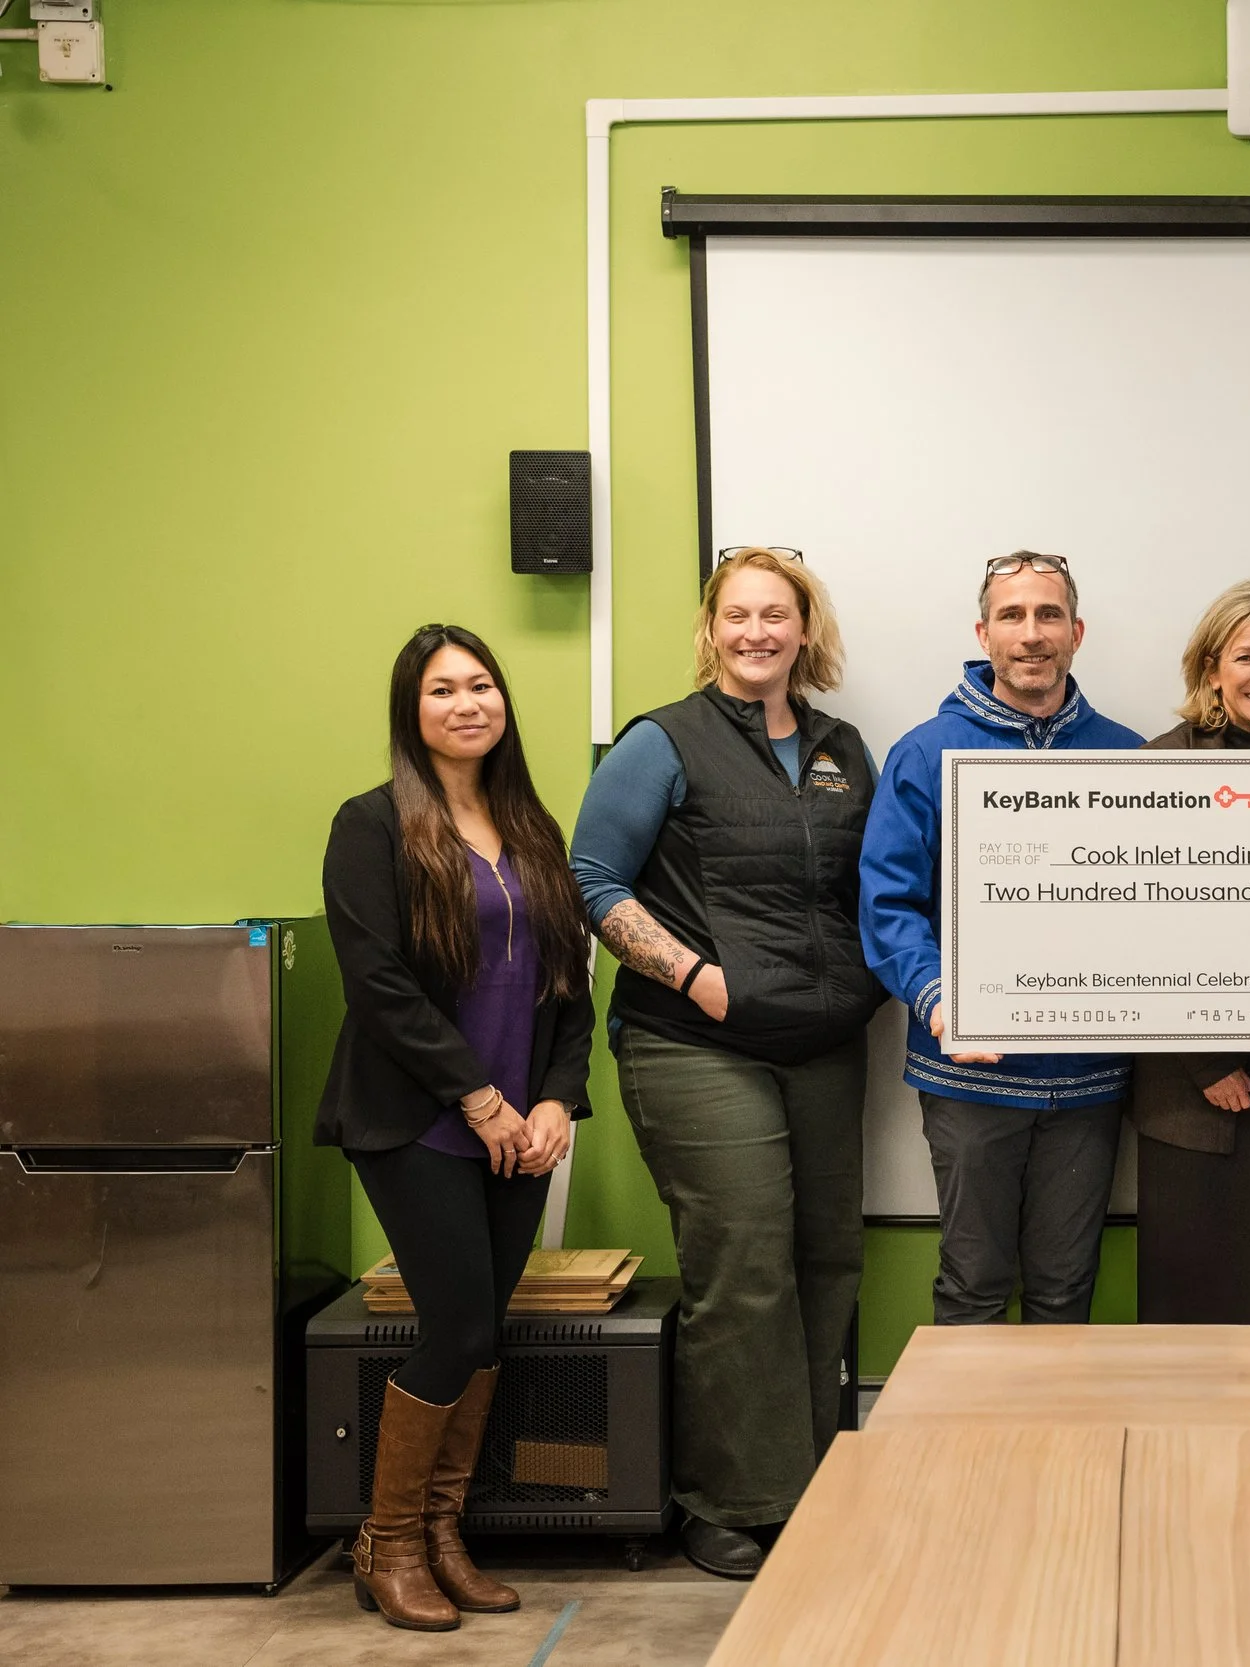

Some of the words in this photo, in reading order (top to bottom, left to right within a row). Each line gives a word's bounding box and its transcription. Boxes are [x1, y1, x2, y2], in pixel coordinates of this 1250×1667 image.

[984, 791, 1080, 812] KeyBank
[1088, 791, 1210, 809] Foundation
[980, 843, 1002, 854] PAY
[1006, 843, 1022, 854] TO
[1026, 843, 1048, 853] THE
[1071, 845, 1128, 864] Cook
[1136, 845, 1181, 863] Inlet
[979, 855, 1020, 865] ORDER
[1025, 855, 1040, 865] OF
[984, 883, 1030, 901] Two
[1038, 882, 1136, 900] Hundred
[980, 984, 1003, 994] FOR
[1016, 972, 1087, 991] Keybank
[1093, 972, 1191, 987] Bicentennial
